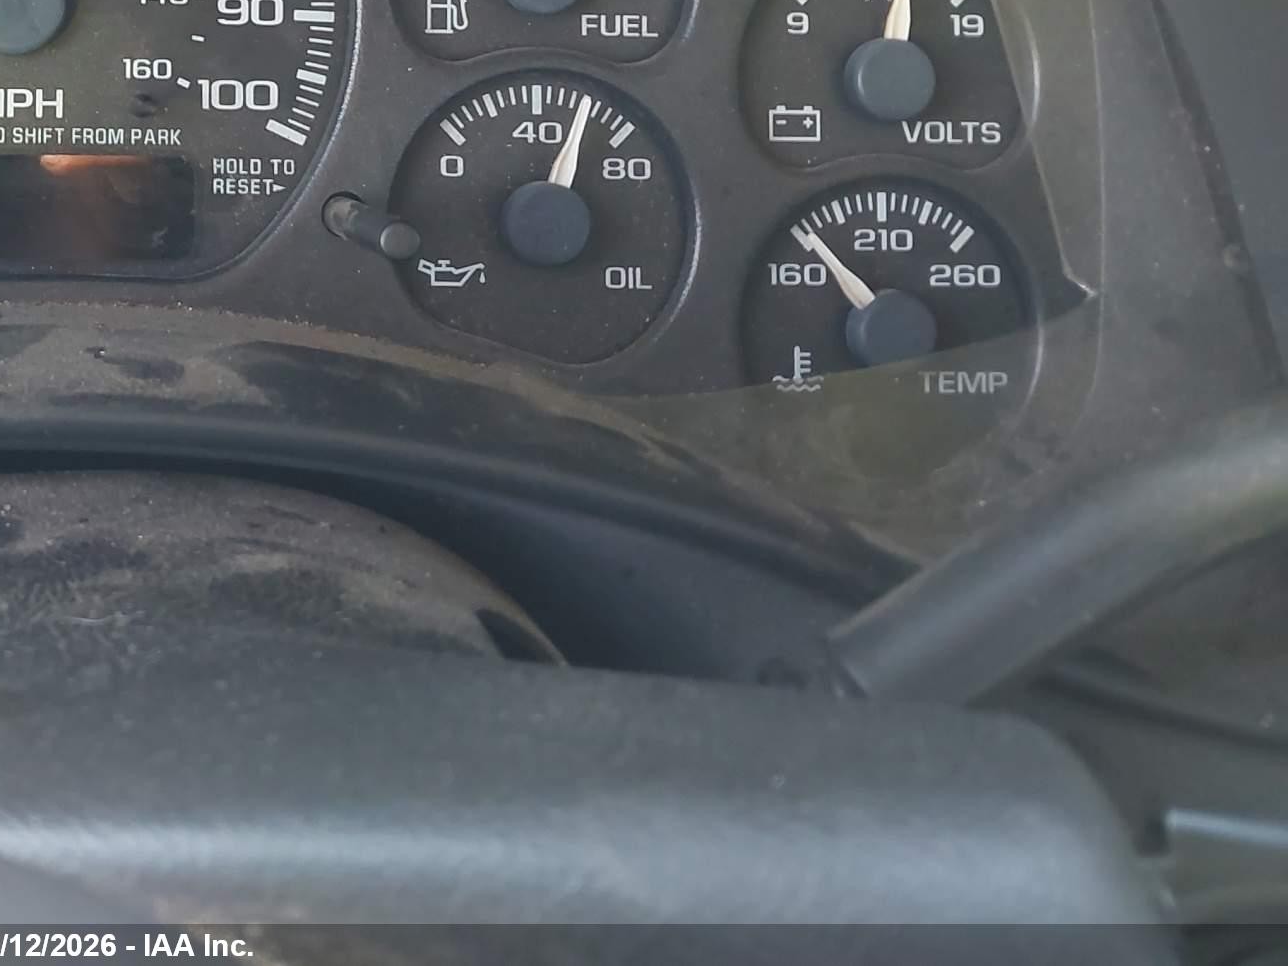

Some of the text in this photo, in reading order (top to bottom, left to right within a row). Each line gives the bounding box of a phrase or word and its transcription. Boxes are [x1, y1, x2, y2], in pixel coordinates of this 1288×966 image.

[582, 15, 658, 37] FUEL
[787, 12, 808, 34] 9
[950, 15, 984, 36] 19
[123, 59, 171, 79] 160
[198, 80, 278, 110] 100
[13, 127, 64, 144] SHIFT
[72, 128, 124, 144] FROM
[131, 129, 180, 145] PARK
[513, 122, 562, 143] 40
[903, 122, 1000, 143] VOLTS
[213, 158, 294, 175] HOLD TO
[441, 156, 463, 176] 0
[603, 158, 651, 180] 80
[213, 178, 273, 195] RESET
[854, 229, 912, 250] 210
[606, 267, 652, 289] OIL
[769, 263, 827, 286] 160
[930, 265, 1000, 286] 260
[920, 372, 1007, 393] TEMP
